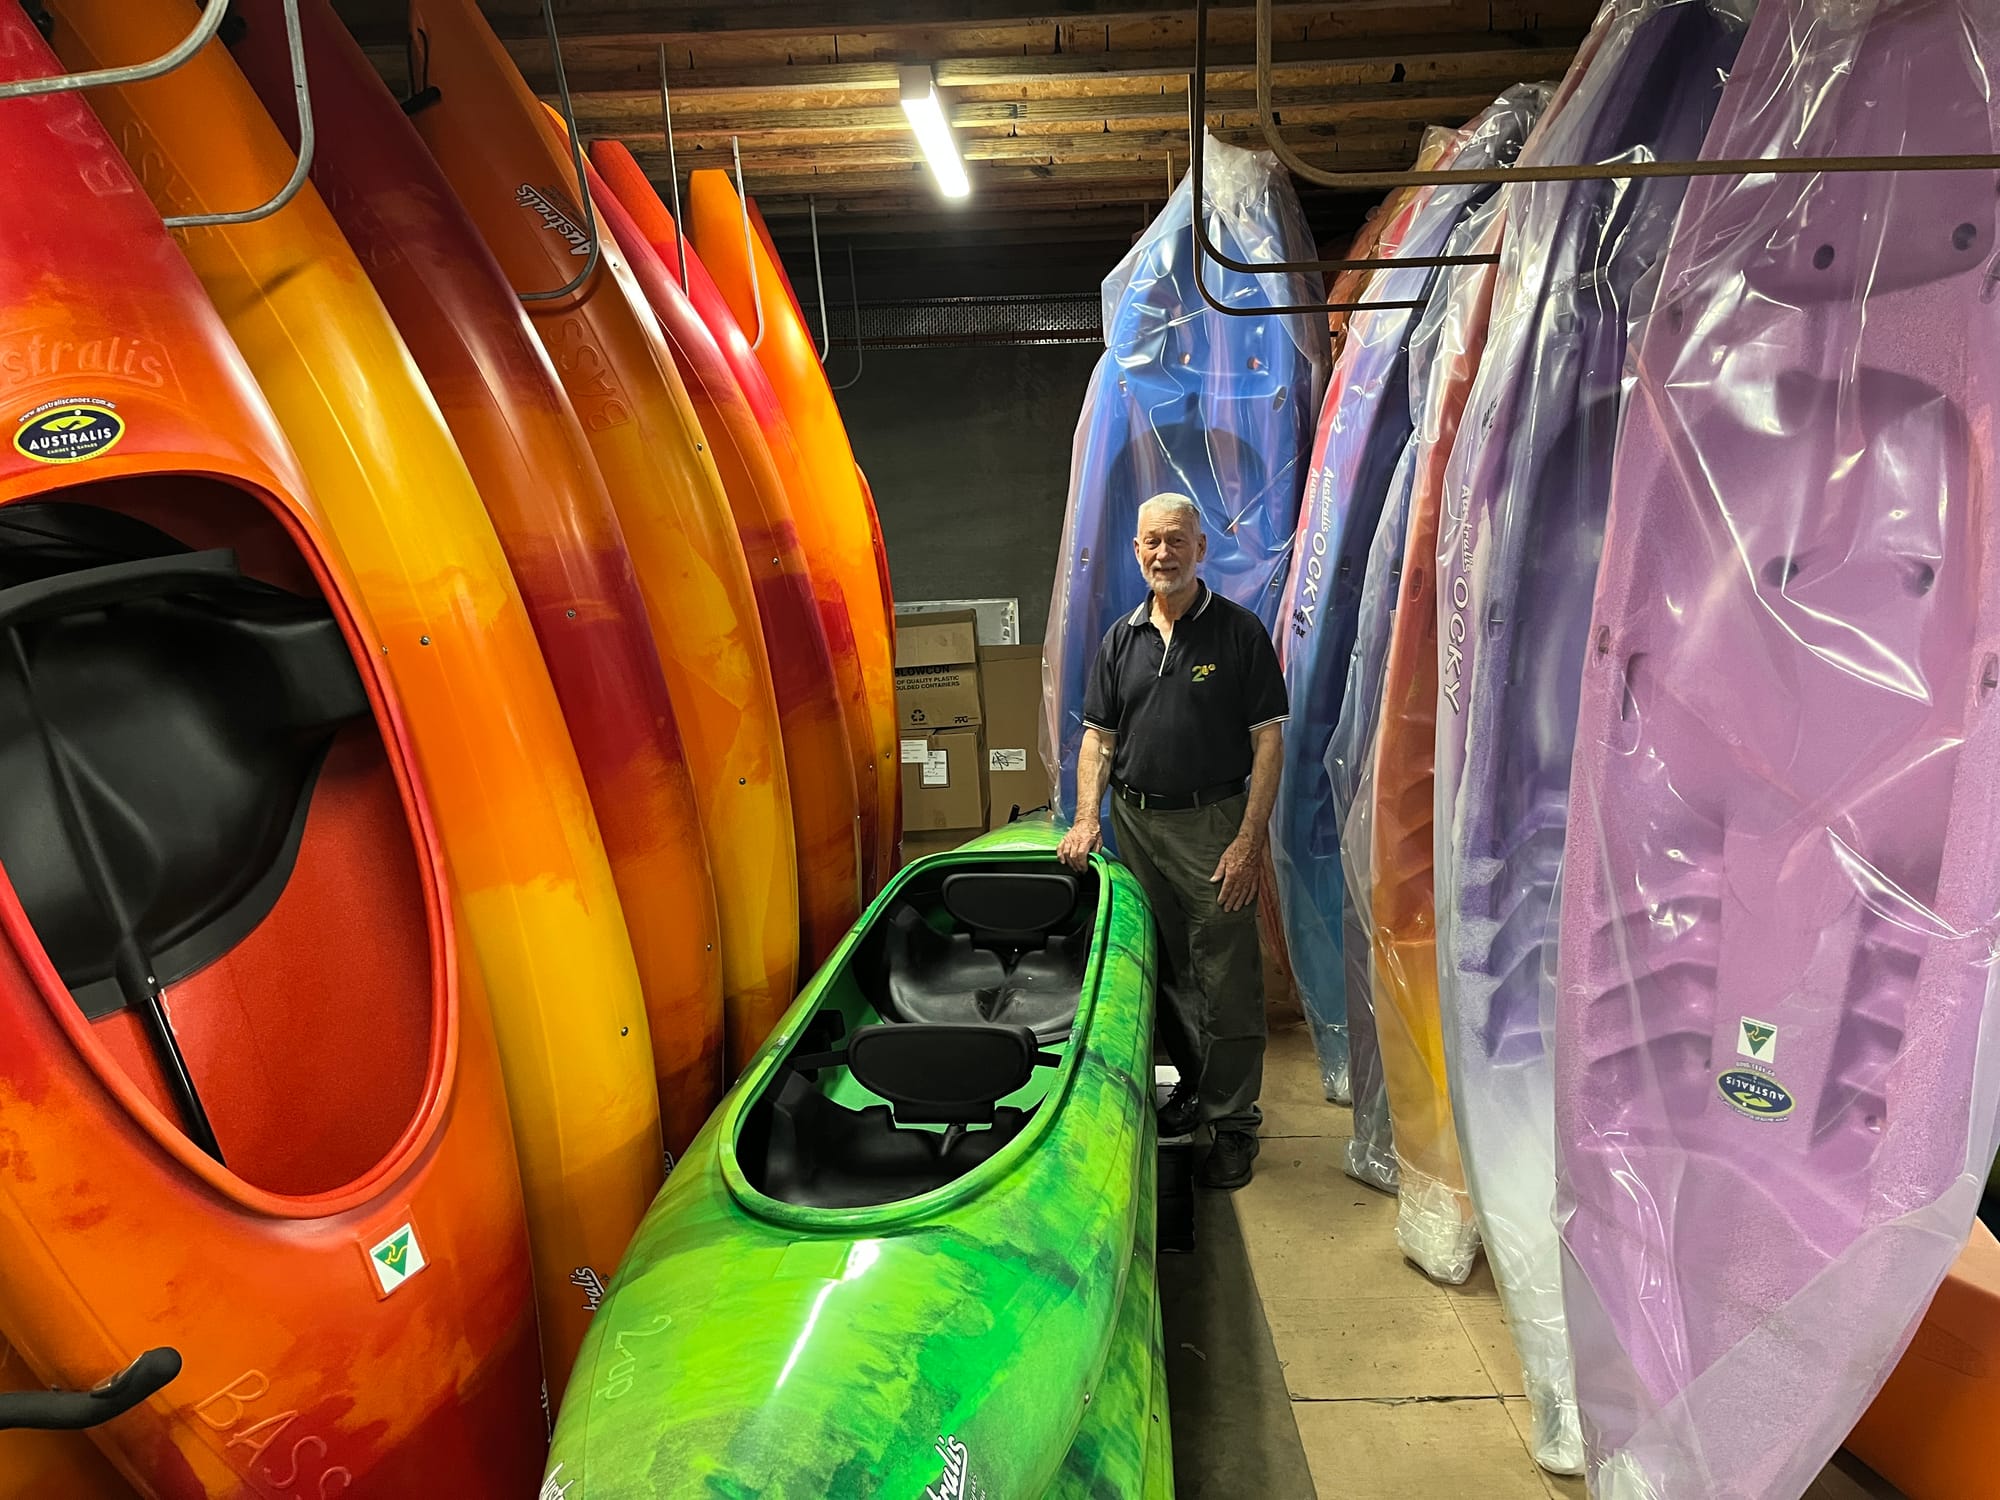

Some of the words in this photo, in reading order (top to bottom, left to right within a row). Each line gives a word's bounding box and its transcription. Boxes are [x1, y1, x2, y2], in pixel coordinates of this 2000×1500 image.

[516, 183, 597, 256] Australis
[0, 333, 165, 389] stralis
[29, 427, 112, 451] AUSTRALIS
[1322, 466, 1336, 533] Australis
[1300, 531, 1327, 628] OCKY
[1444, 575, 1470, 715] OCKY
[921, 681, 960, 689] CONTAINERS
[1726, 1076, 1785, 1101] AUSTRALIS
[569, 1266, 606, 1312] tralis
